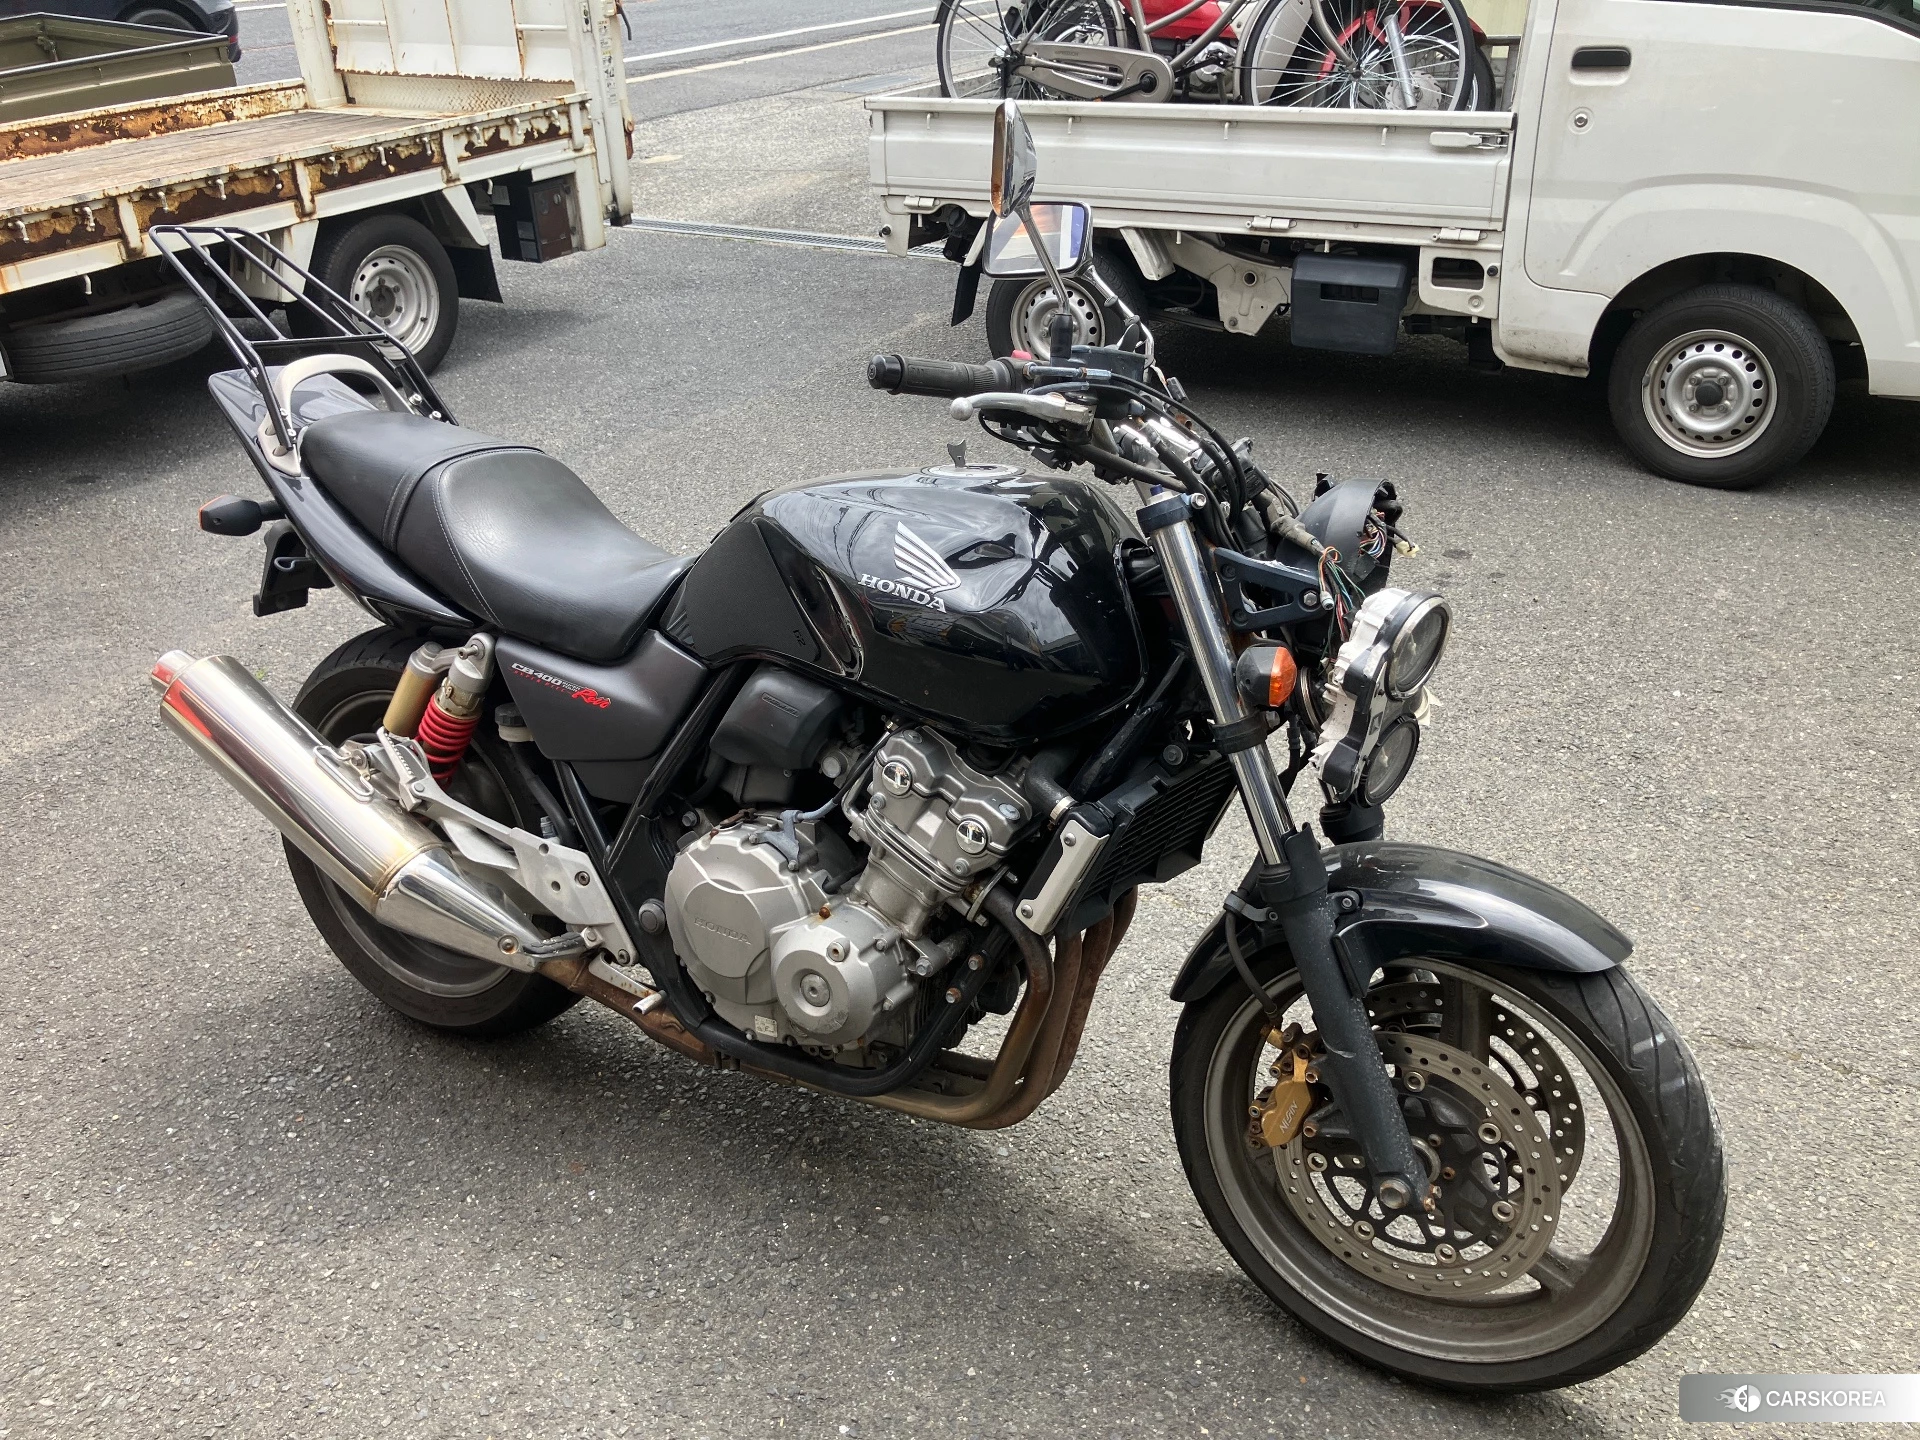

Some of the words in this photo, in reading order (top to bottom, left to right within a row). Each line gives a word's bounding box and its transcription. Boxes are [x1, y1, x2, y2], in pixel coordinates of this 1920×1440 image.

[858, 573, 947, 614] HONDA
[511, 662, 562, 686] CB400
[694, 916, 752, 946] HONDA
